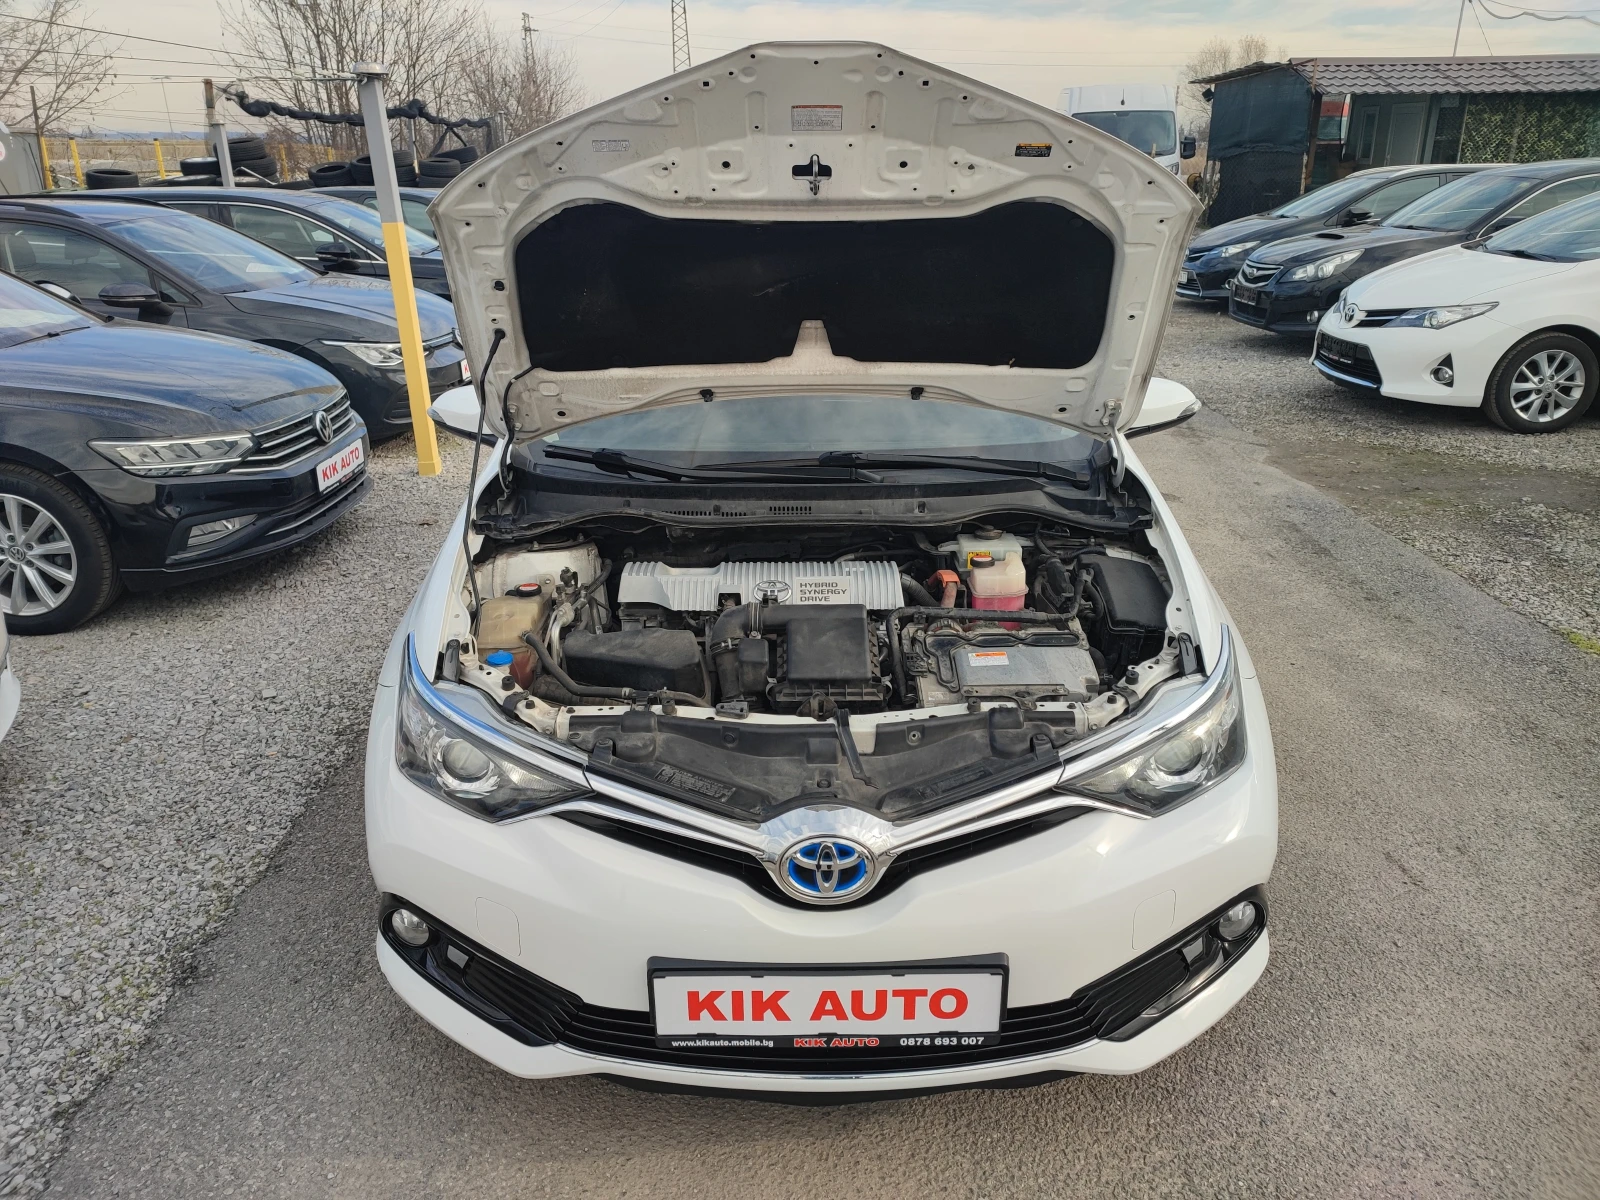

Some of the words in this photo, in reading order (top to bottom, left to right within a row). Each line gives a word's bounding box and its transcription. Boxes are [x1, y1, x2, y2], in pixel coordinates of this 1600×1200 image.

[322, 460, 338, 482] KIK
[341, 446, 360, 471] AUTO
[687, 990, 792, 1022] KIK
[809, 988, 969, 1022] AUTO
[671, 1039, 774, 1048] www.kikauto.mobile.bg
[793, 1037, 827, 1048] KIK
[830, 1037, 880, 1047] AUTO
[899, 1037, 931, 1046] 0878
[934, 1037, 957, 1046] 693
[961, 1036, 985, 1045] 007
